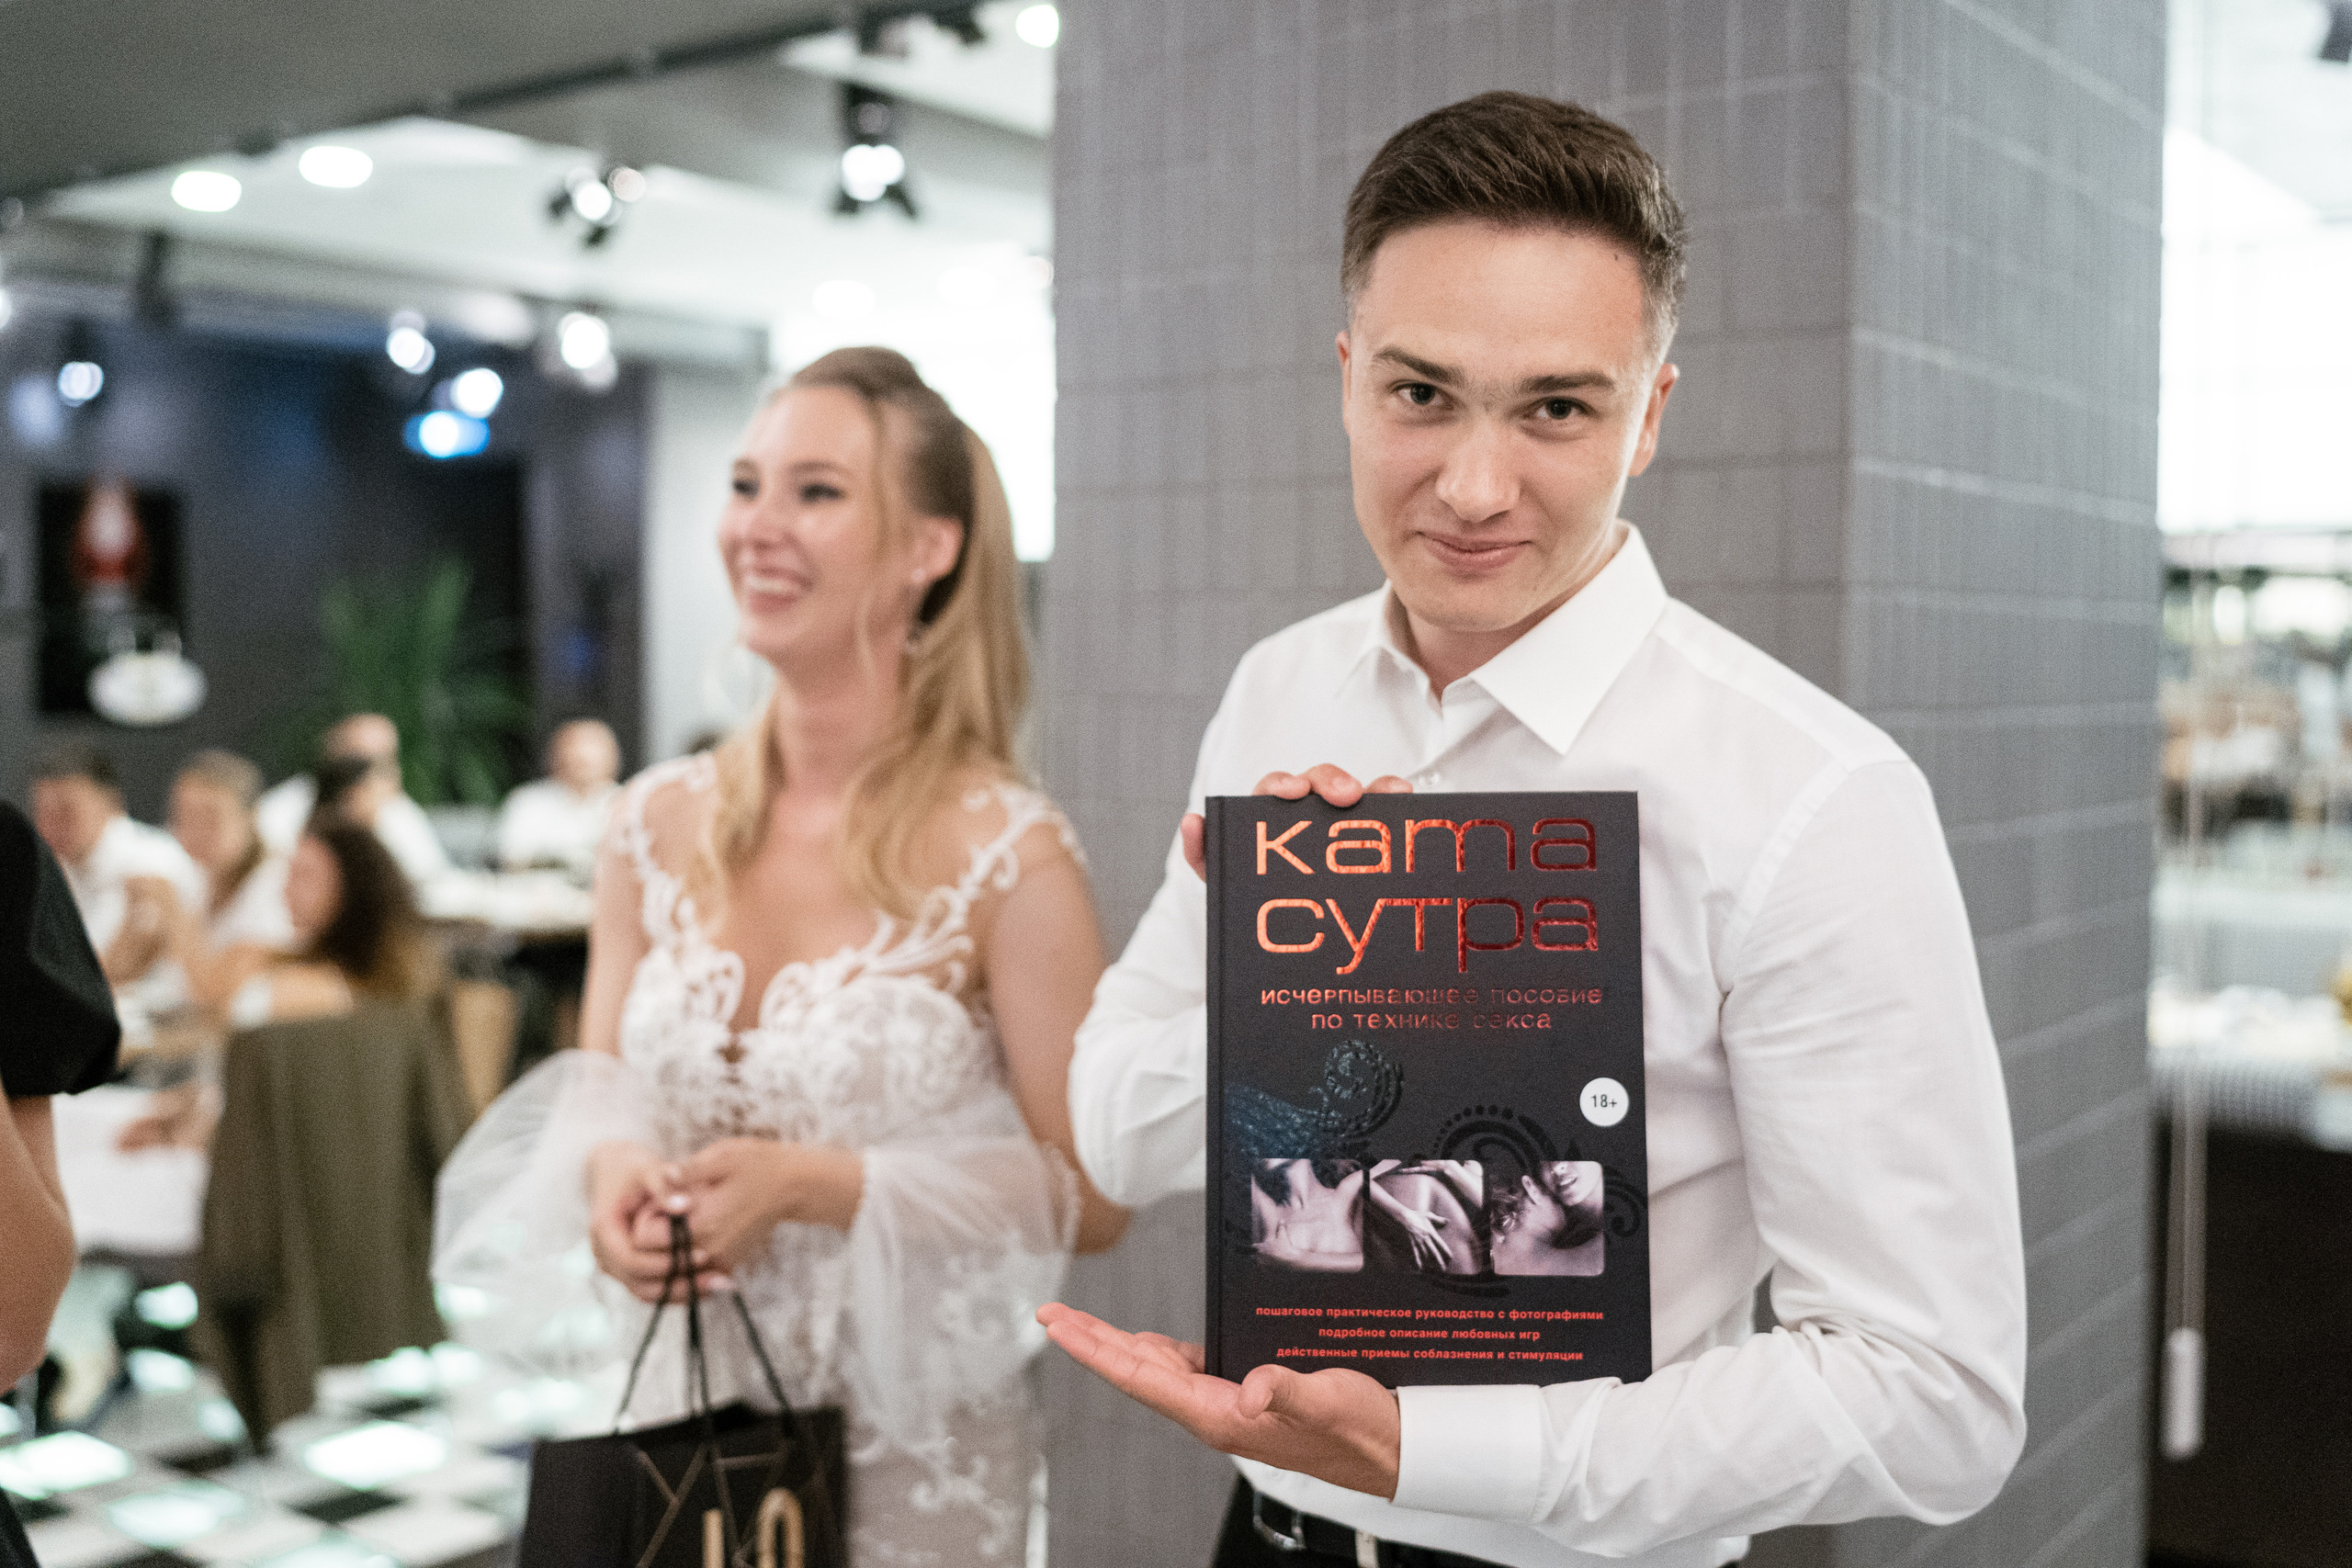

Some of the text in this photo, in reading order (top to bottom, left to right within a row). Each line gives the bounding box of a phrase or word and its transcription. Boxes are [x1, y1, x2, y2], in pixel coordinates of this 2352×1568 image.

[1256, 897, 1599, 976] сутра
[1491, 987, 1602, 1004] пособие
[1311, 1012, 1552, 1029] по технике секса
[1591, 1093, 1618, 1108] 18+
[1256, 1307, 1604, 1321] пошаговое практическое руководство с фотографиями
[1318, 1326, 1541, 1341] подробное описание любовных игр
[1276, 1347, 1584, 1362] действенные приемы соблазнения и стимуляции
